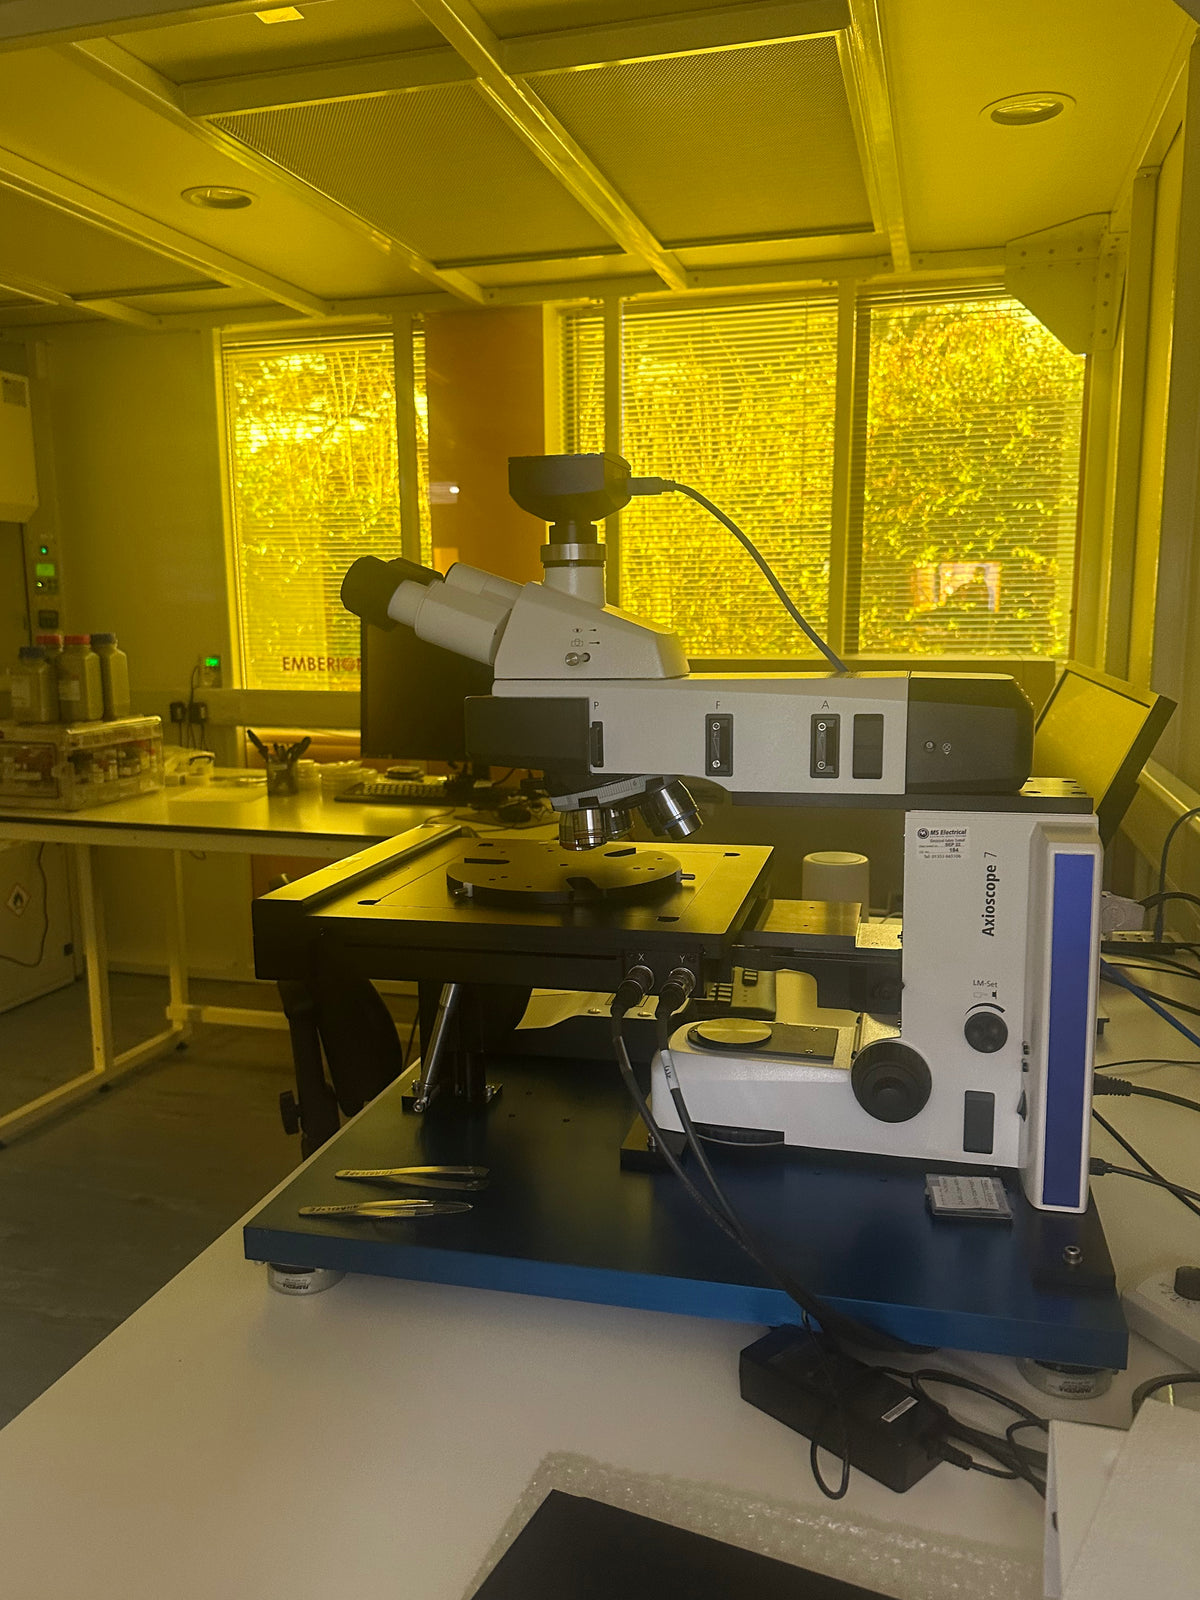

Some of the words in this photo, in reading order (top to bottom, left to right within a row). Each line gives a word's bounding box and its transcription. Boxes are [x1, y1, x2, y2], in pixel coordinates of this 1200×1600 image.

[593, 701, 600, 711] P
[715, 700, 721, 710] F
[821, 700, 829, 709] A
[983, 851, 998, 859] 7
[982, 865, 1000, 937] Axioscope
[638, 953, 645, 961] X
[679, 954, 686, 963] Y
[972, 979, 998, 988] LM-Set
